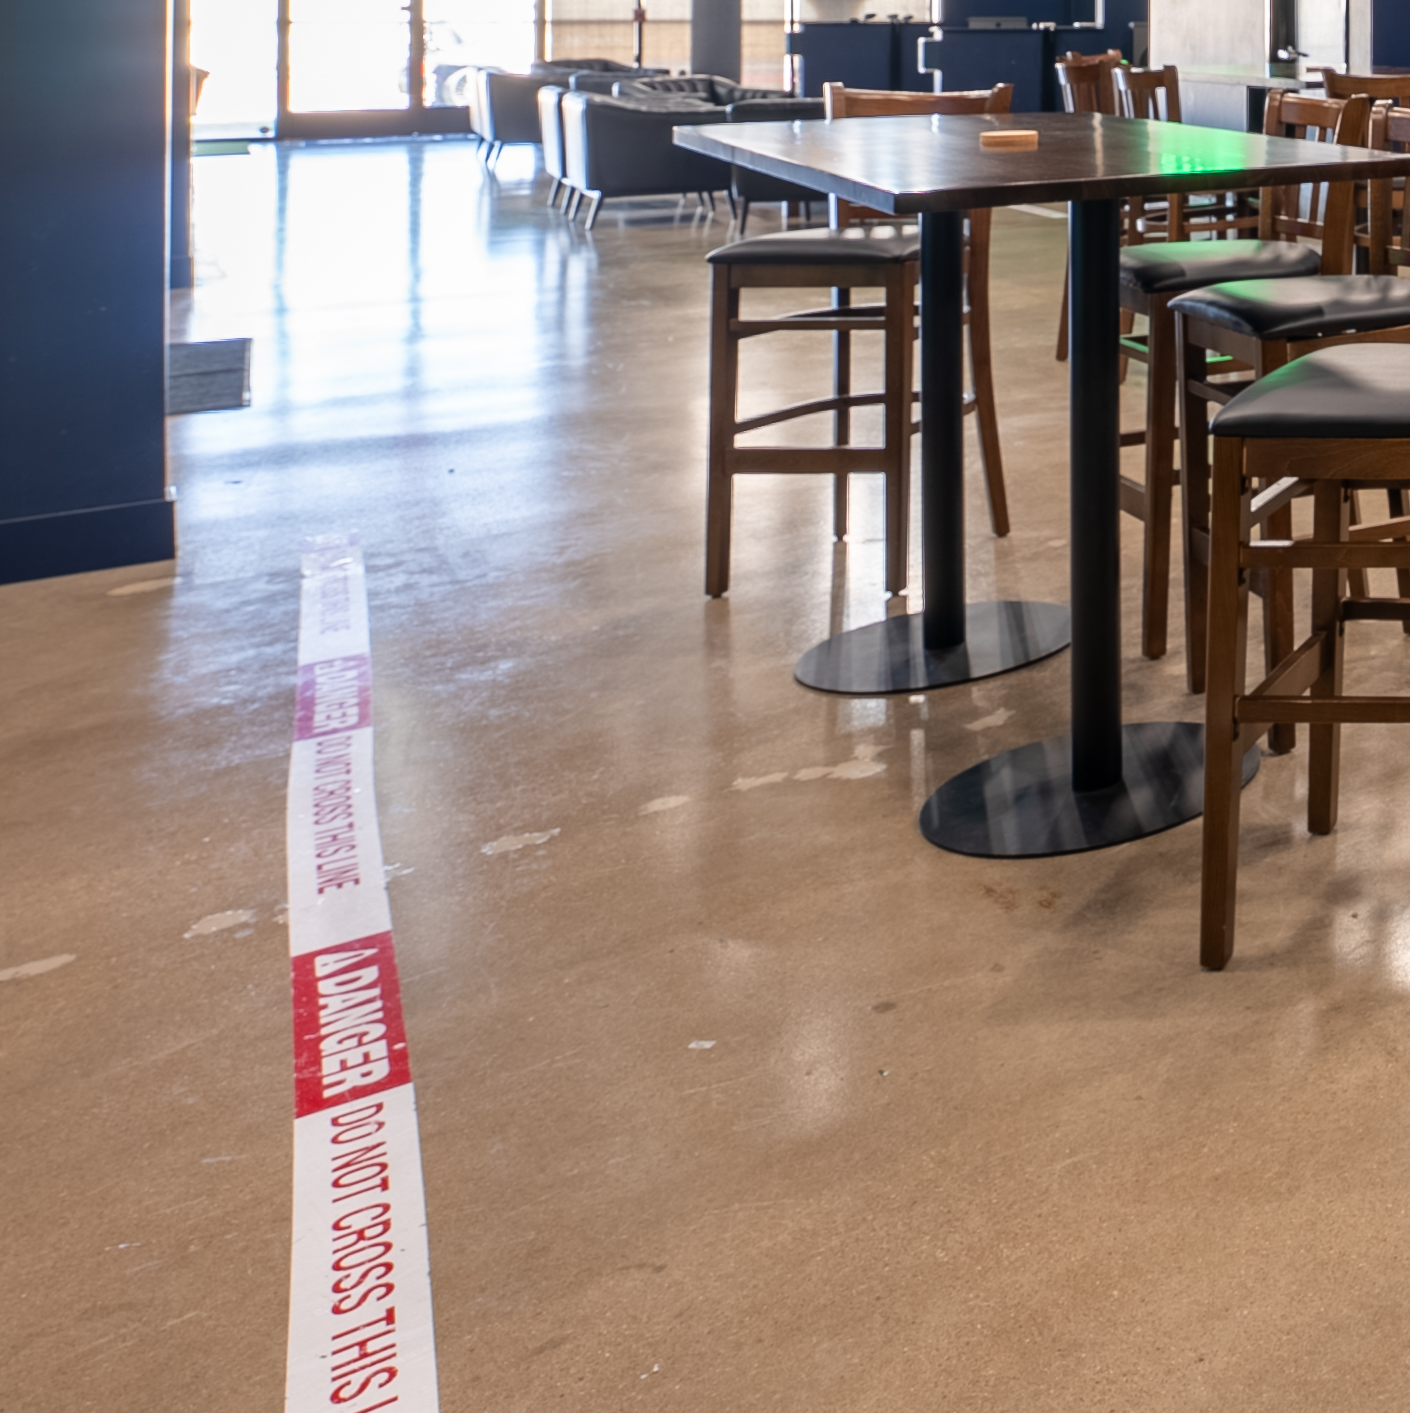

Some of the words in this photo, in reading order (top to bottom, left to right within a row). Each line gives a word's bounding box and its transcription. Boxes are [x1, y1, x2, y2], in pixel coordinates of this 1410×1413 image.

[317, 964, 392, 1100] DANGER
[330, 1101, 387, 1145] DO
[331, 1141, 390, 1204] NOT
[331, 1202, 396, 1316] CROSS
[330, 1306, 399, 1405] THIS
